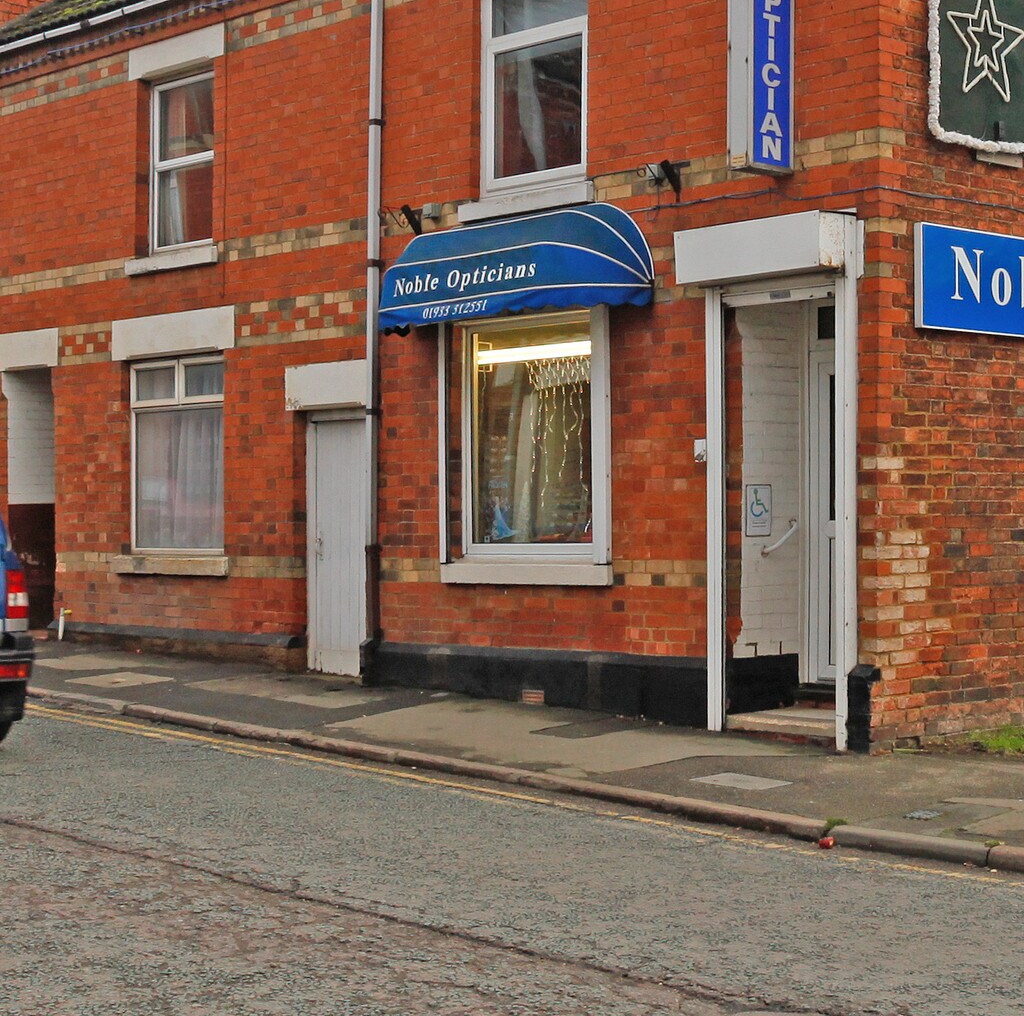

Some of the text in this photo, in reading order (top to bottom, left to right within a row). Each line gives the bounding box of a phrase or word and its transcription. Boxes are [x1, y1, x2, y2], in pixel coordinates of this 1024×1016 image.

[393, 263, 537, 297] Noble Opticians
[422, 299, 488, 319] 01933 312551
